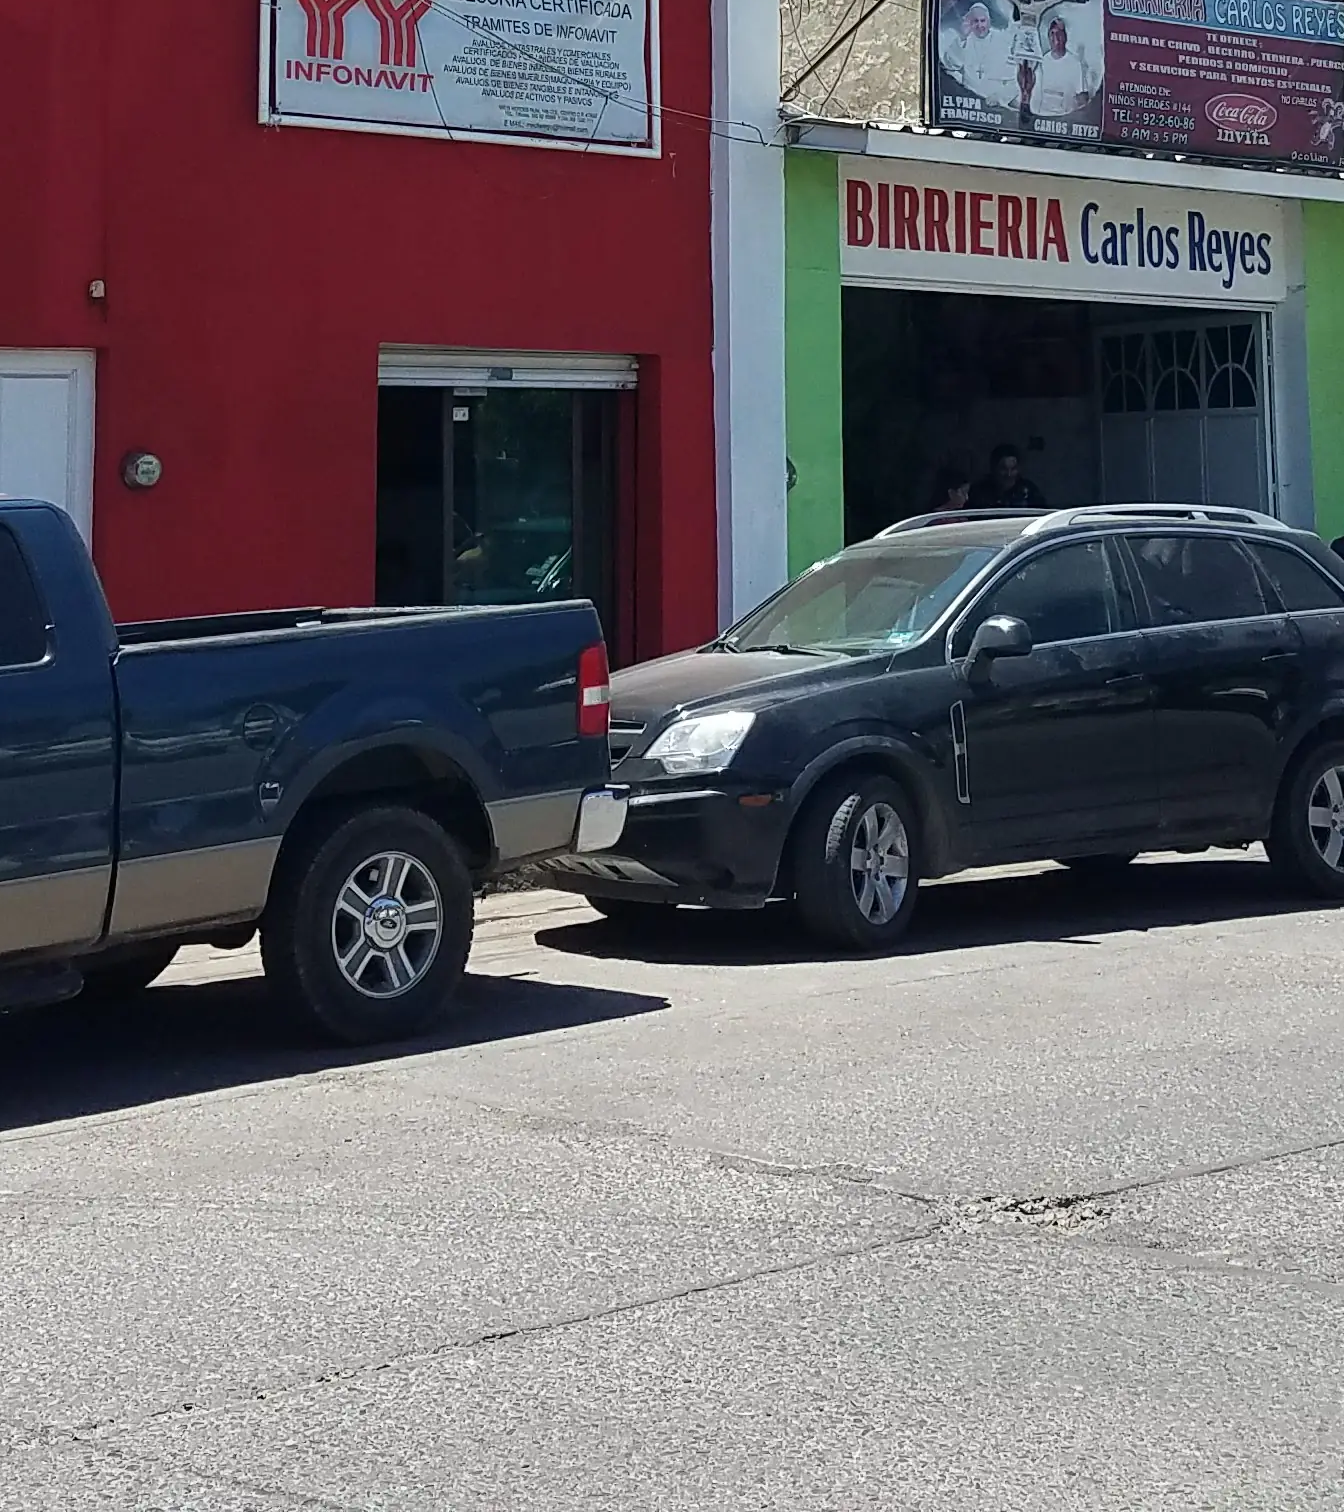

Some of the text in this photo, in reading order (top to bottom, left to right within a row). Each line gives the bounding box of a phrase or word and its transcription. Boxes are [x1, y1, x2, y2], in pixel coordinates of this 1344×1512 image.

[464, 14, 618, 44] TRAMITES DE INFONAVIT
[1109, 31, 1150, 46] BIRRIA
[1151, 37, 1167, 48] DE
[1178, 54, 1225, 69] PEDIDOS
[285, 59, 435, 93] INFONAVIT
[1129, 60, 1332, 94] Y SERVICIOS PARA EVENTOS ESPECIALES
[1119, 81, 1157, 95] ATENDIDO
[942, 95, 982, 111] EL PAPA
[1108, 92, 1136, 107] NIÑOS
[1137, 97, 1171, 111] HEROES
[940, 108, 1002, 125] FRANCISCO
[1212, 101, 1269, 126] Coca-Cola
[1033, 118, 1100, 138] CARLOS REYES
[1120, 126, 1129, 138] 8
[1131, 127, 1151, 141] AM
[1162, 131, 1169, 143] 5
[1171, 132, 1188, 145] PM
[1216, 126, 1271, 146] invita
[844, 178, 1273, 288] BIRRIERIA Carlos Reyes
